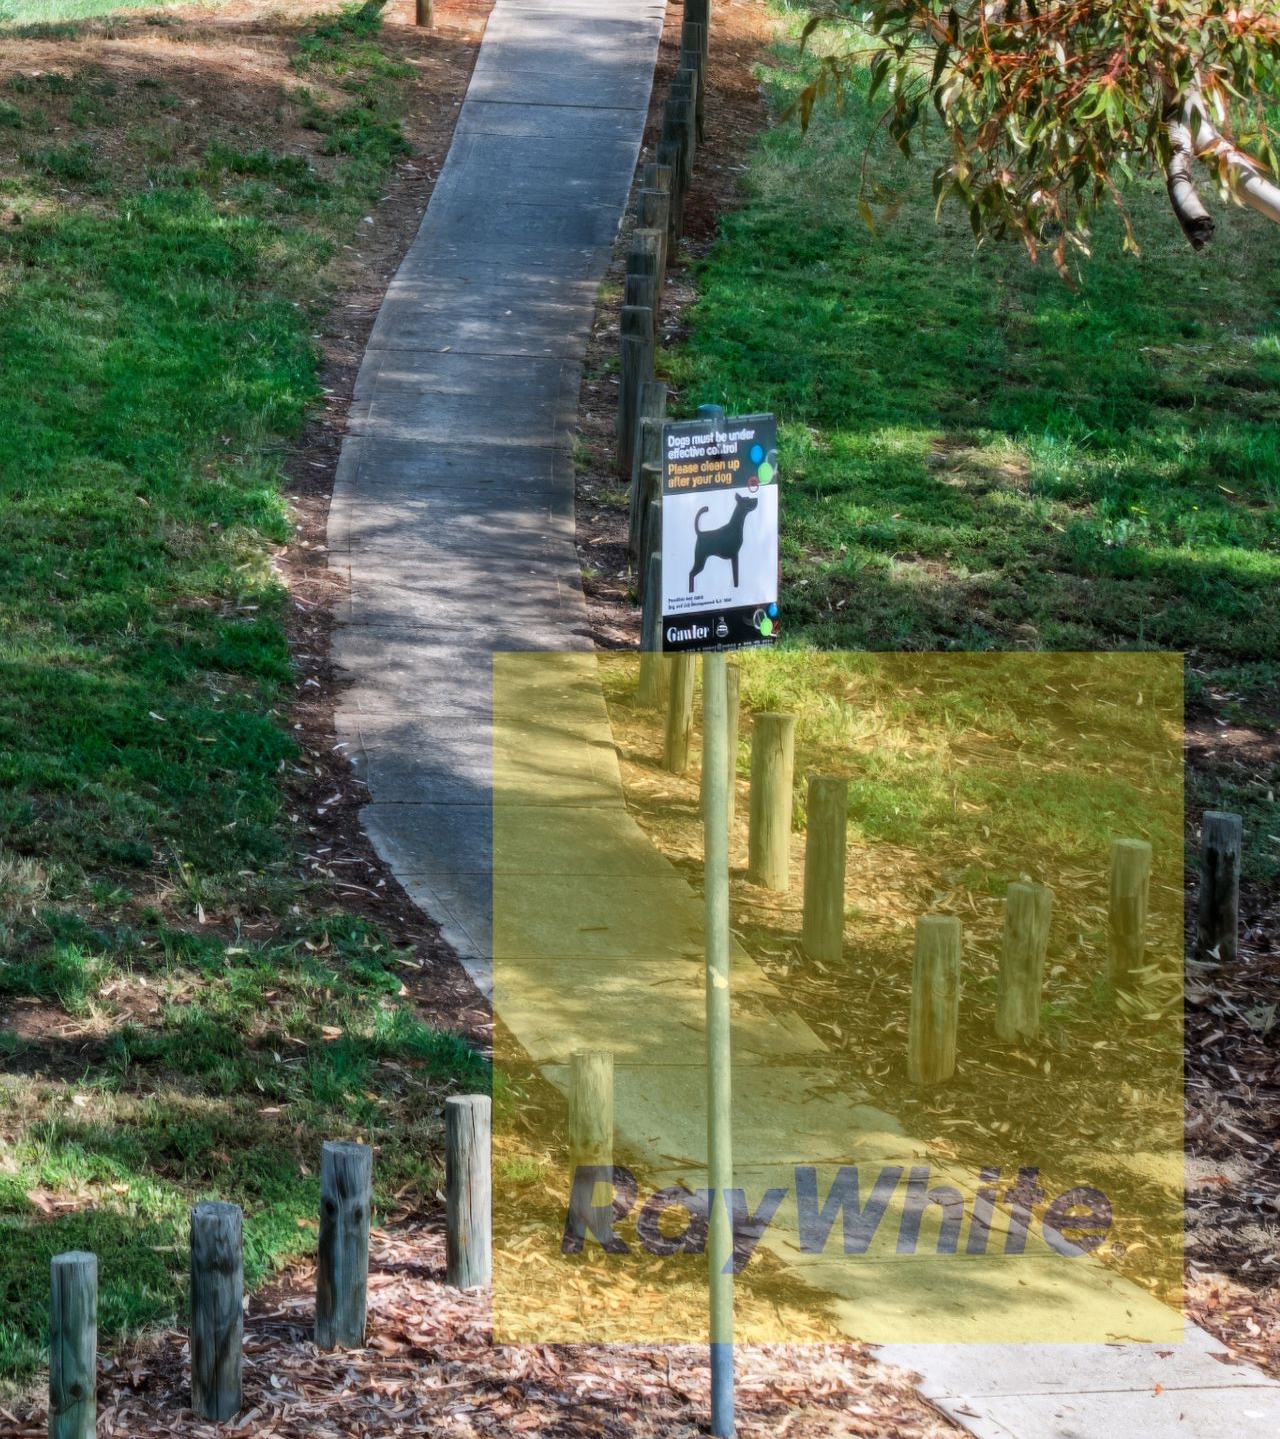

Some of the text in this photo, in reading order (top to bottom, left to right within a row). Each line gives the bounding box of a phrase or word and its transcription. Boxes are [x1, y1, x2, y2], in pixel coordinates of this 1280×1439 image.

[667, 429, 755, 447] Dogs must be under
[667, 446, 705, 460] effective
[668, 459, 740, 475] Please clean up
[668, 472, 732, 488] after your dog
[666, 624, 710, 643] Gawler
